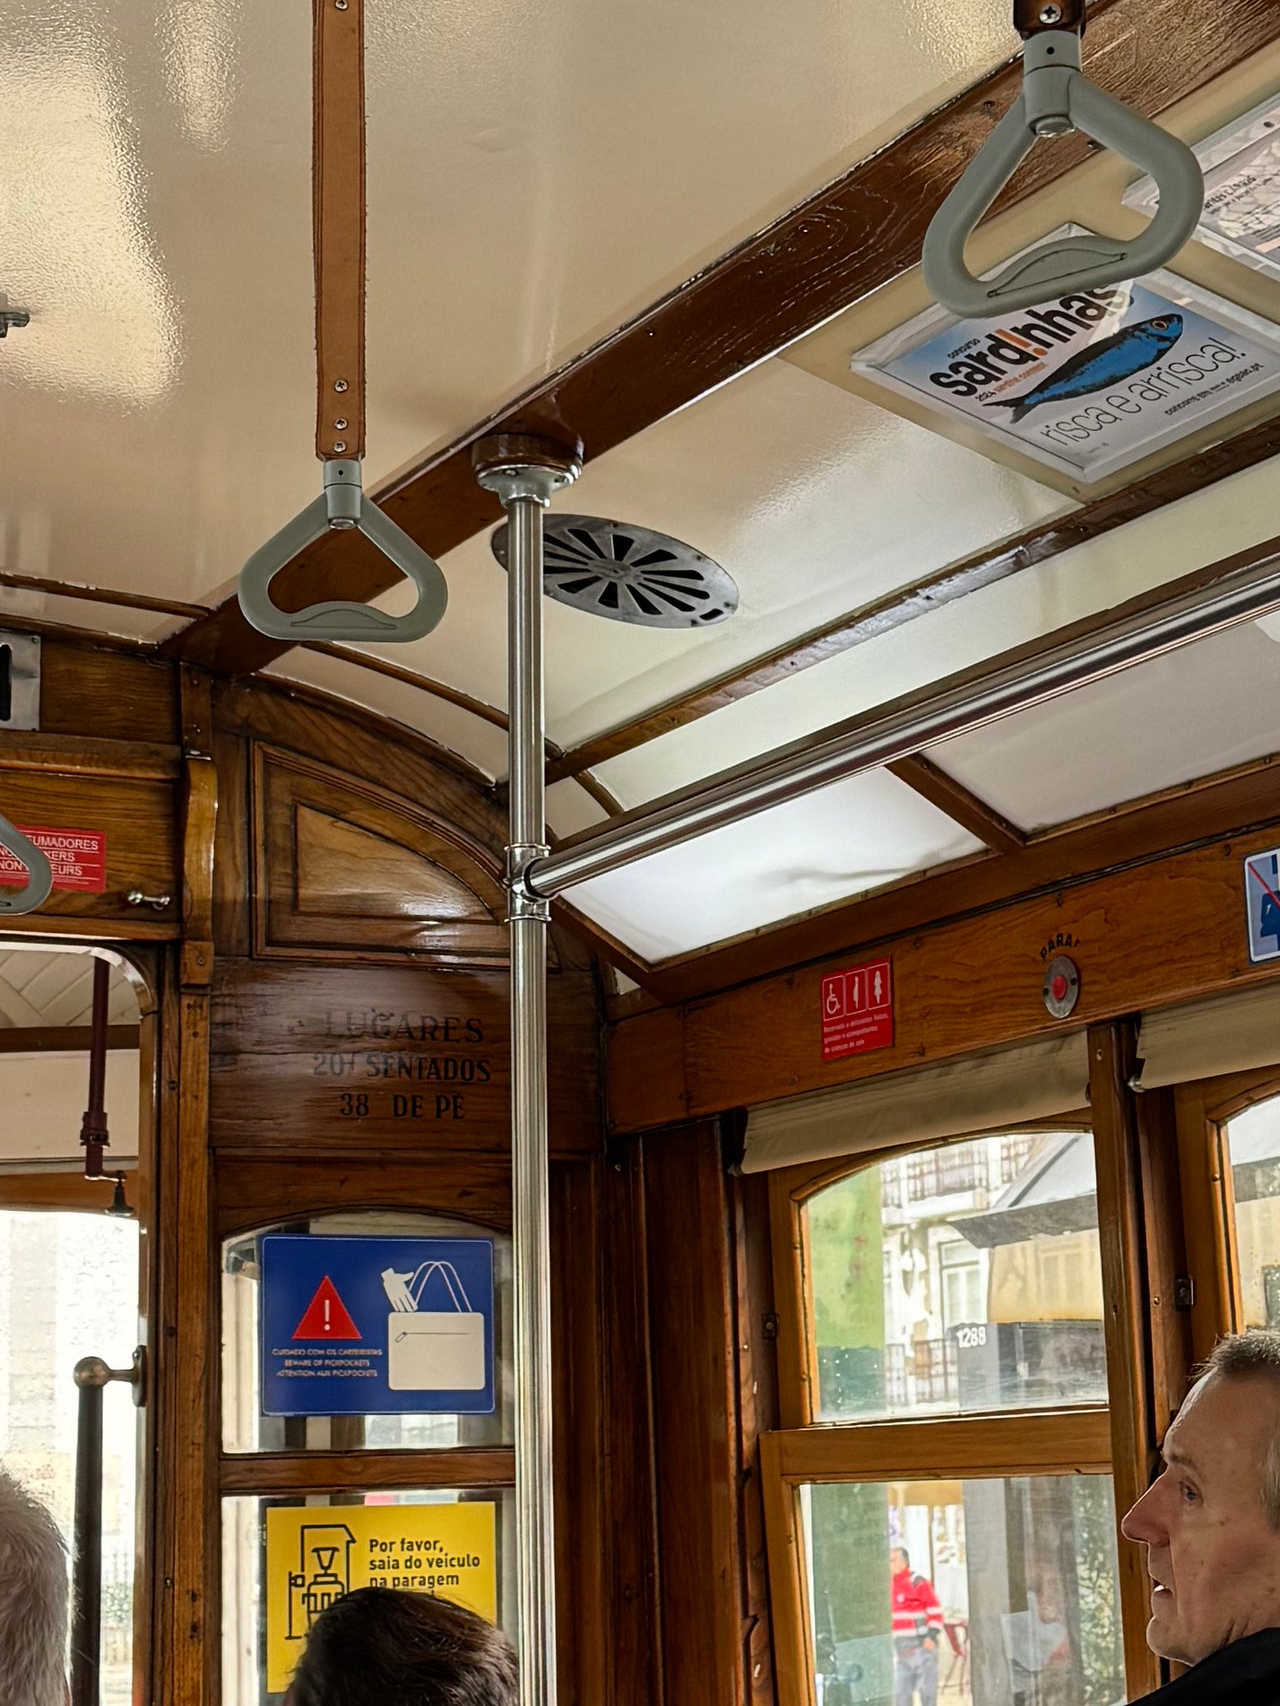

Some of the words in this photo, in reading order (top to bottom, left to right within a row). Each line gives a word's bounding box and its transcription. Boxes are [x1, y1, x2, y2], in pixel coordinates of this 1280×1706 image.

[1040, 406, 1123, 445] risca
[1106, 395, 1141, 414] e
[1128, 337, 1246, 401] arrisca!
[325, 1009, 484, 1043] LUGARES
[366, 1052, 491, 1083] SENTADOS
[340, 1093, 369, 1117] 38
[393, 1094, 424, 1118] DE
[369, 1539, 396, 1553] Por
[400, 1538, 443, 1553] favor,
[369, 1556, 400, 1570] saia
[404, 1555, 422, 1569] do
[369, 1577, 387, 1587] na
[392, 1574, 460, 1589] paragem
